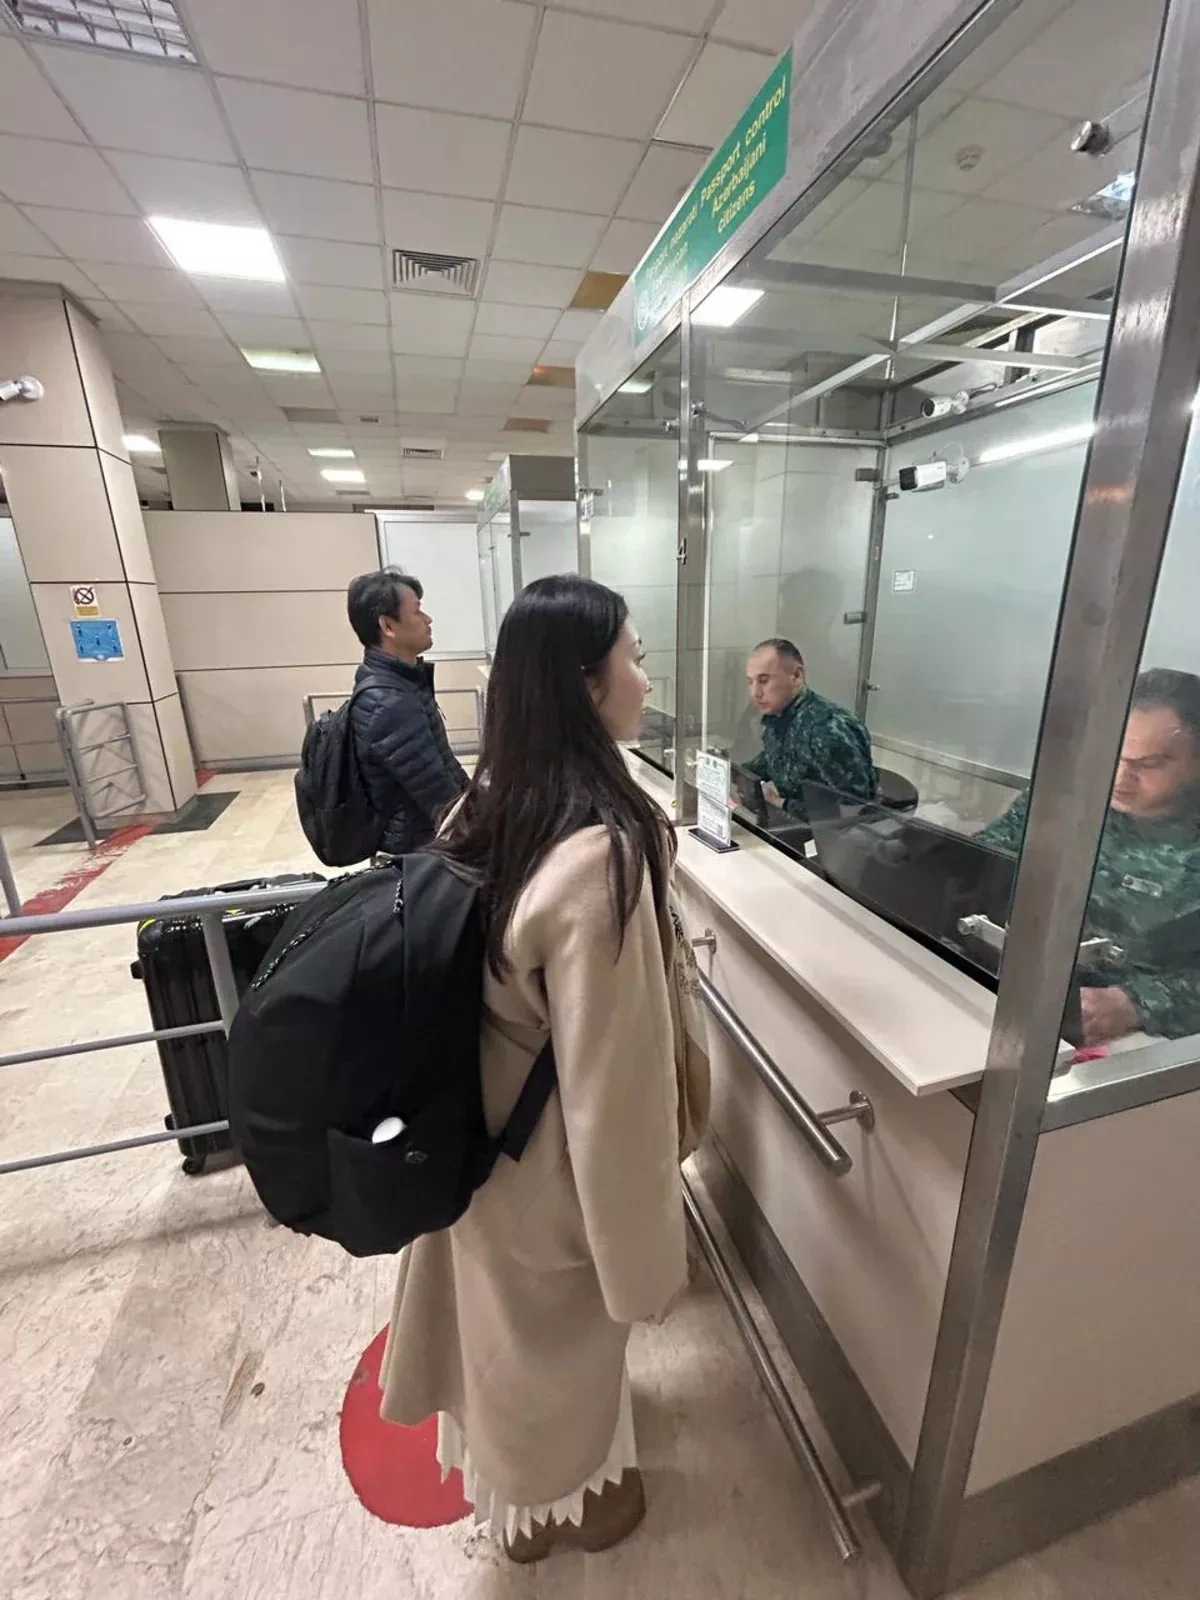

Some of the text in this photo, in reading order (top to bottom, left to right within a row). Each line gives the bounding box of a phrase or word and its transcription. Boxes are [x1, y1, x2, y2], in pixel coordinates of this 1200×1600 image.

[701, 73, 787, 208] Passport control
[711, 131, 767, 218] Azerbaijani
[718, 180, 756, 233] citizens
[675, 537, 687, 566] 4
